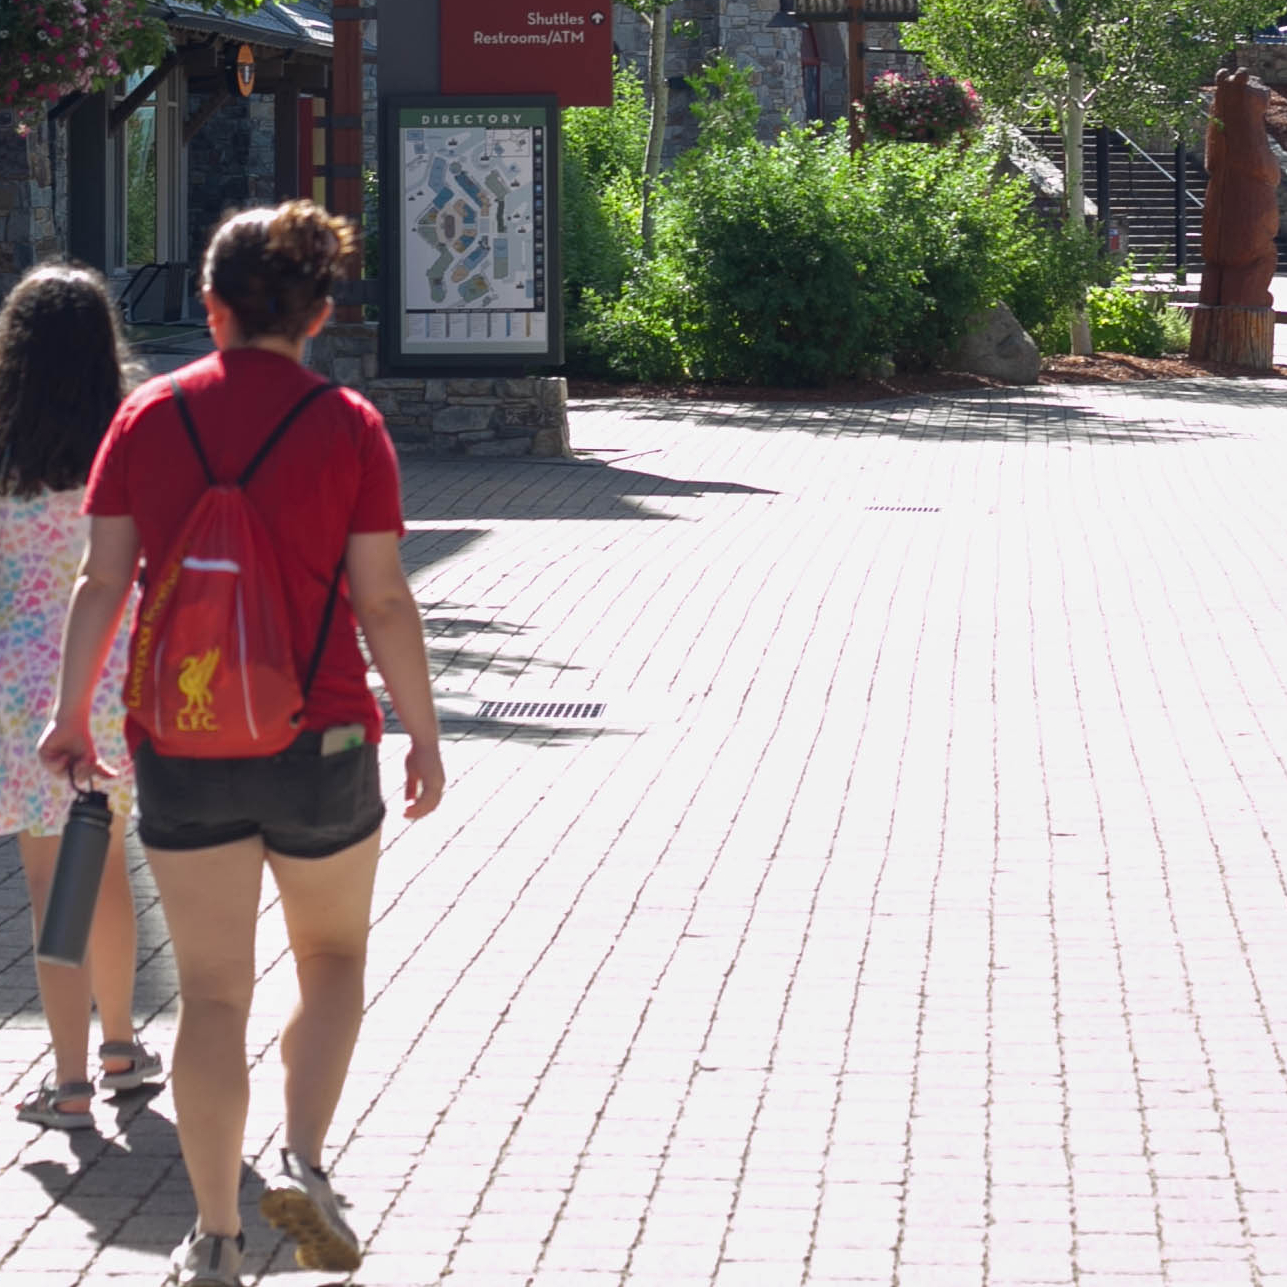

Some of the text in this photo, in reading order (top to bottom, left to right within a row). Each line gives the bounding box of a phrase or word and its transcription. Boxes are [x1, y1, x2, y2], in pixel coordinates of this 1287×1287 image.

[527, 12, 585, 26] Shuttles
[473, 31, 585, 45] Restrooms/ATM
[421, 114, 523, 125] DIRECTORY
